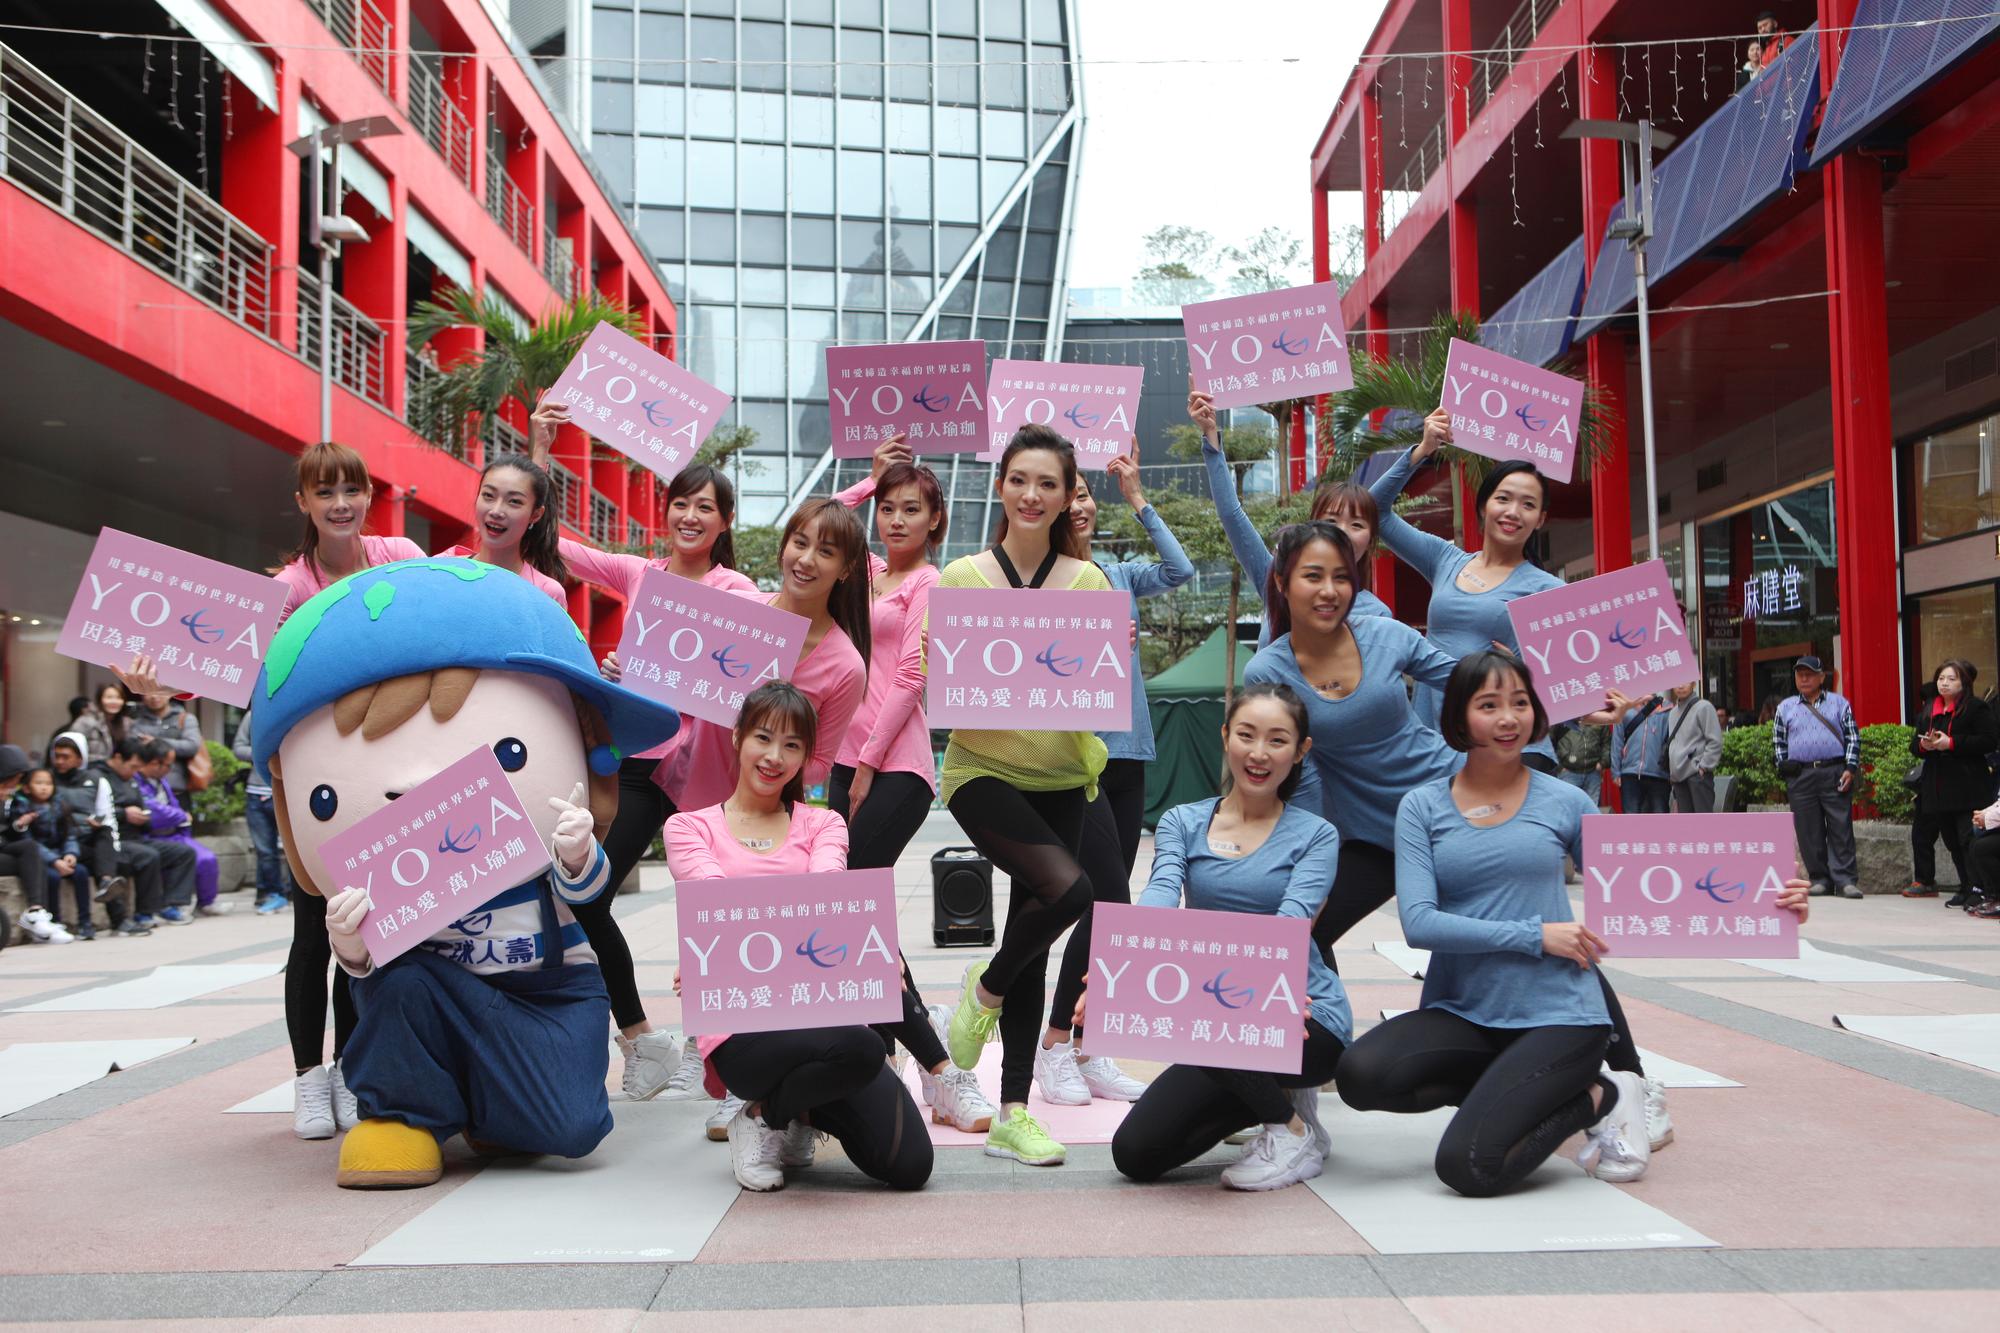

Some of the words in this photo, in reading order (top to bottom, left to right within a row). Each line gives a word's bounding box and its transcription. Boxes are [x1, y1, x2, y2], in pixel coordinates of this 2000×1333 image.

[1199, 304, 1327, 333] 用愛締造幸福的世界紀錄
[597, 343, 709, 414] 用愛締造幸福的世界紀錄
[841, 363, 972, 379] 用愛締造幸福的世界紀錄
[1001, 379, 1127, 396] 用愛締造幸福的世界紀錄
[1459, 361, 1570, 407] 用愛締造幸福的世界紀錄
[107, 556, 265, 613] 用愛締造幸福的世界紀錄
[1743, 564, 1801, 619] 麻膳堂
[650, 594, 787, 649] 用愛締造幸福的世界紀錄
[946, 615, 1113, 630] 用愛締造幸福的世界紀錄
[1528, 586, 1659, 633] 用愛締造幸福的世界紀錄
[344, 776, 490, 871] 用愛締造幸福的世界紀錄
[1601, 841, 1776, 855] 用愛締造幸福的世界紀錄
[697, 899, 877, 923] 用愛締造幸福的世界紀錄
[1110, 934, 1290, 961] 用愛締造幸福的世界紀錄
